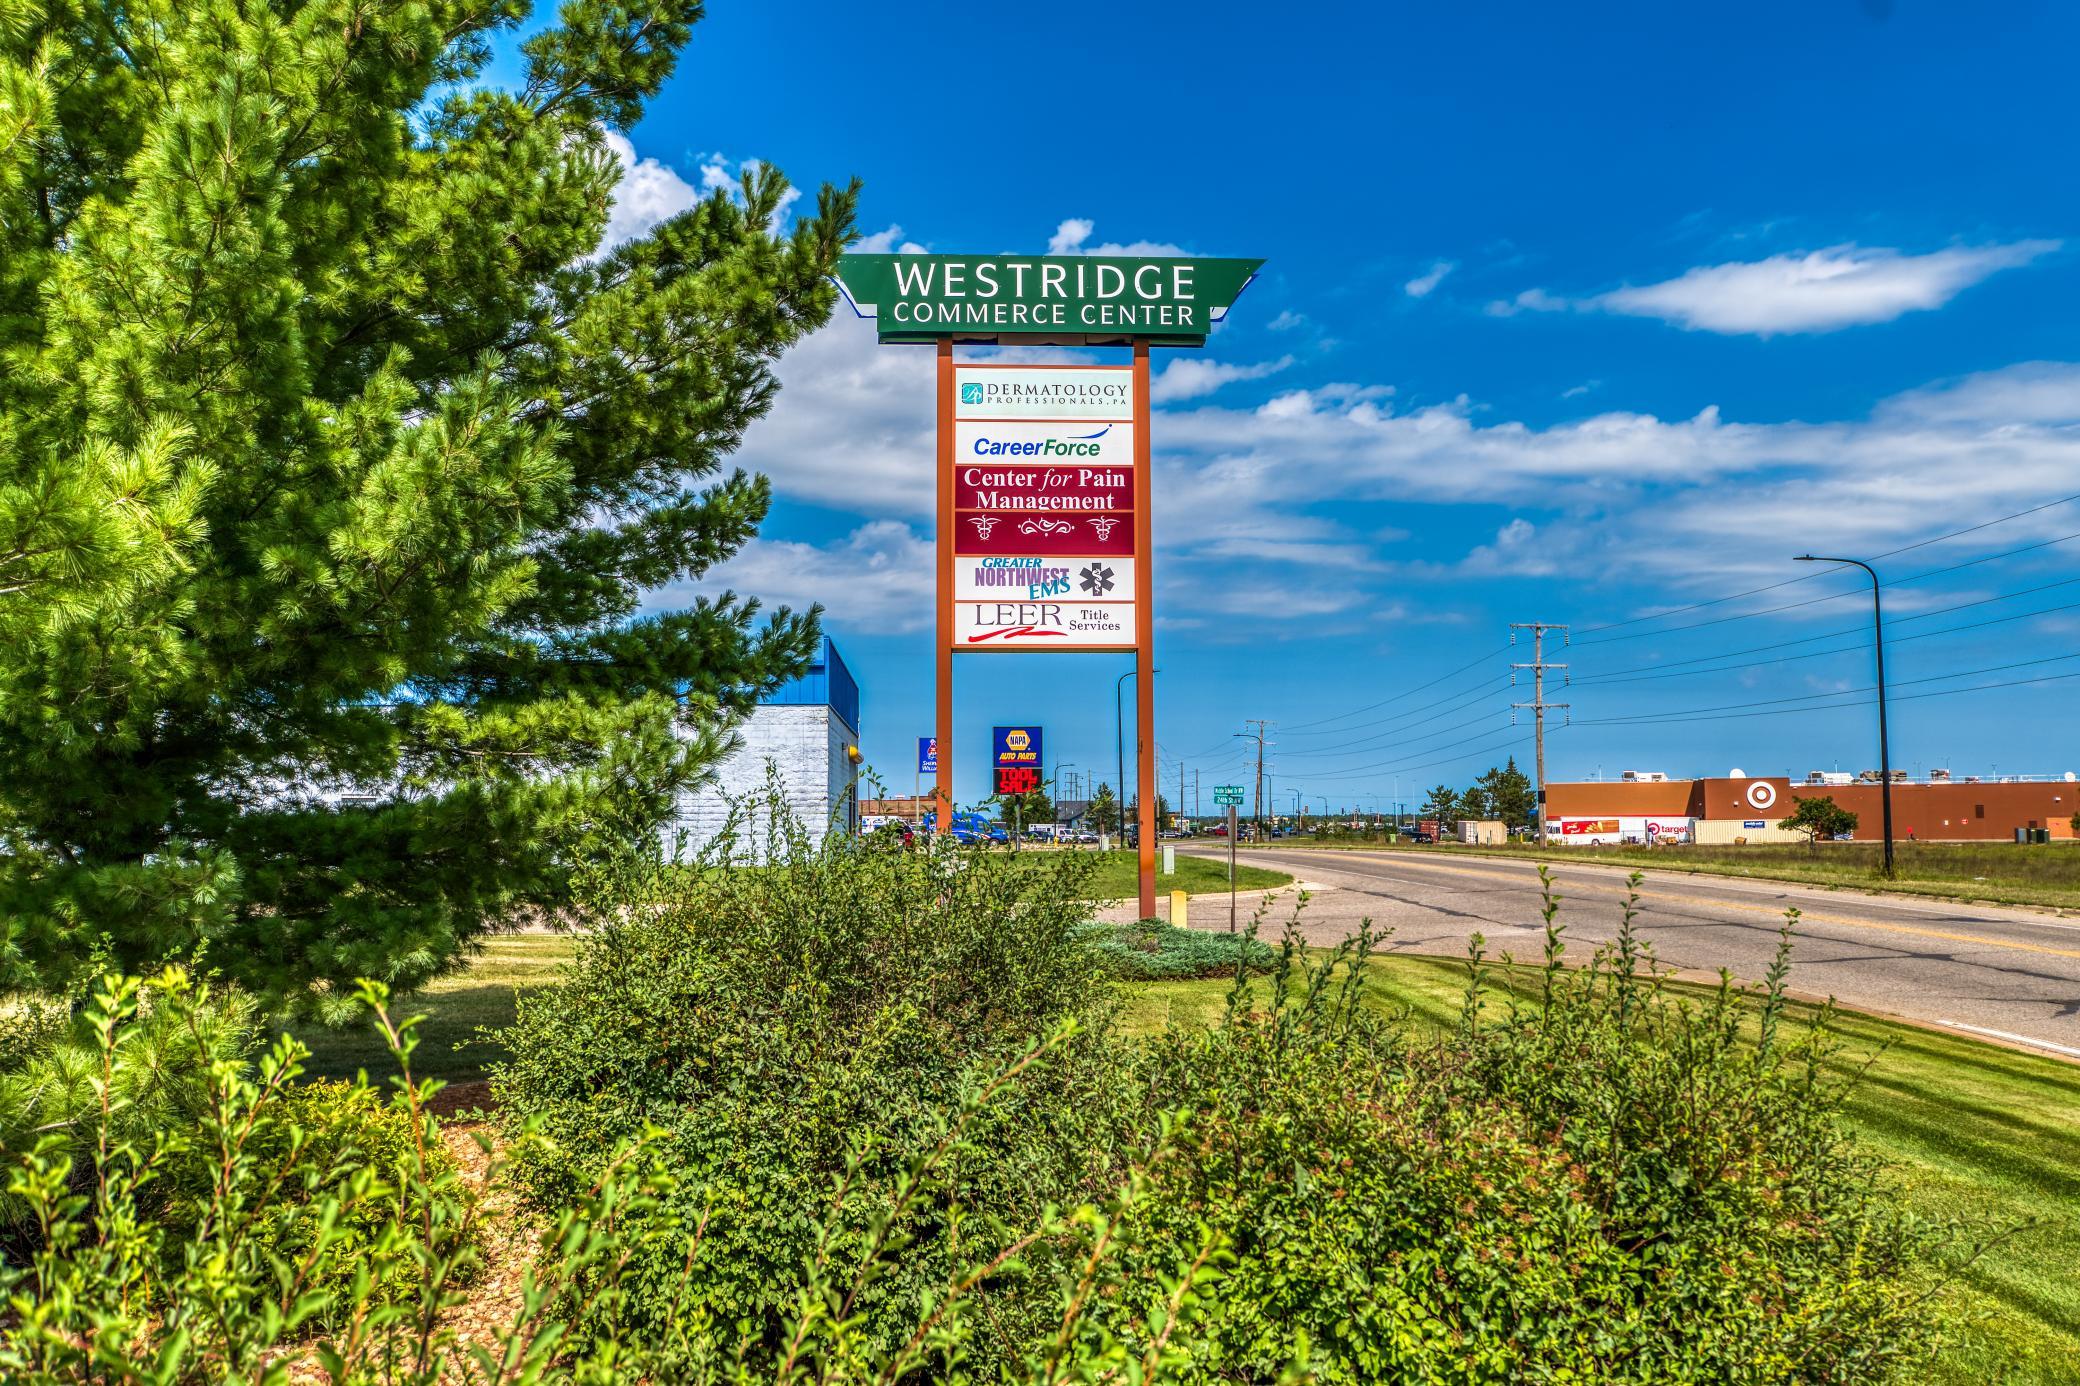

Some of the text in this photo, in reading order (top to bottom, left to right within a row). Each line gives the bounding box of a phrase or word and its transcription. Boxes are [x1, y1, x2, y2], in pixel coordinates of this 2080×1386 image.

[893, 262, 1195, 300] WESTRIDGE
[893, 302, 1193, 326] COMMERCE CENTER
[987, 383, 1127, 396] DERMATOLOGY
[974, 438, 1100, 456] CareerForce
[964, 468, 1125, 492] Center for Pain
[975, 491, 1114, 511] Management
[982, 557, 1042, 568] GREATER
[975, 567, 1070, 587] NORTHWEST
[1029, 576, 1071, 600] EMS
[974, 604, 1062, 626] LEER
[1080, 610, 1109, 620] Title
[1069, 620, 1121, 631] Services
[1010, 735, 1027, 745] NAPA
[999, 752, 1037, 760] AUTO PARTS
[999, 768, 1038, 781] TOOL
[999, 780, 1037, 793] SALE
[1661, 825, 1688, 834] target
